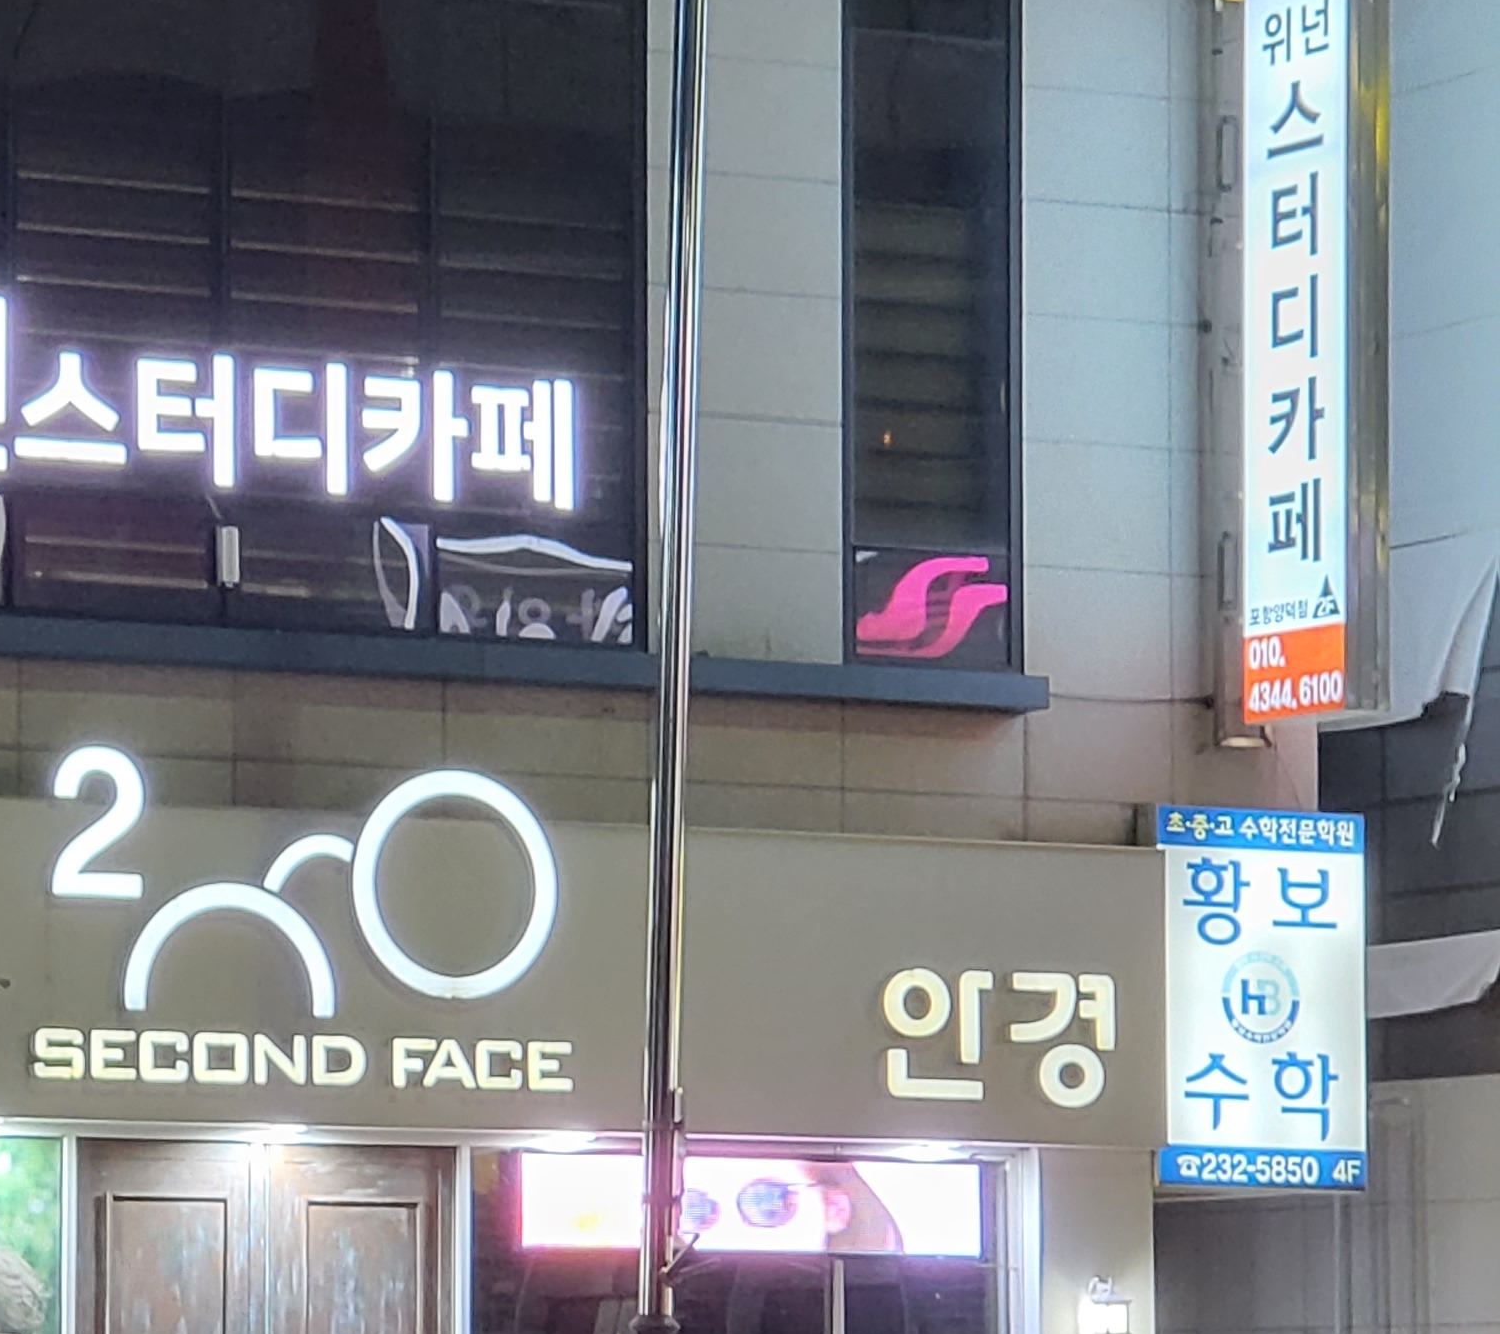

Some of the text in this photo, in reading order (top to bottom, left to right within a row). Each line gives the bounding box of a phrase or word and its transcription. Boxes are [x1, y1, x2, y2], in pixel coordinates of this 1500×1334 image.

[1265, 78, 1326, 564] 스터디카페
[1238, 815, 1356, 848] 수학전문학원
[1182, 856, 1338, 946] 황보
[32, 1027, 575, 1092] SECOND FACE
[882, 967, 1116, 1108] 안경
[1183, 1050, 1339, 1143] 수학
[1200, 1151, 1361, 1185] 232-5850 4F
